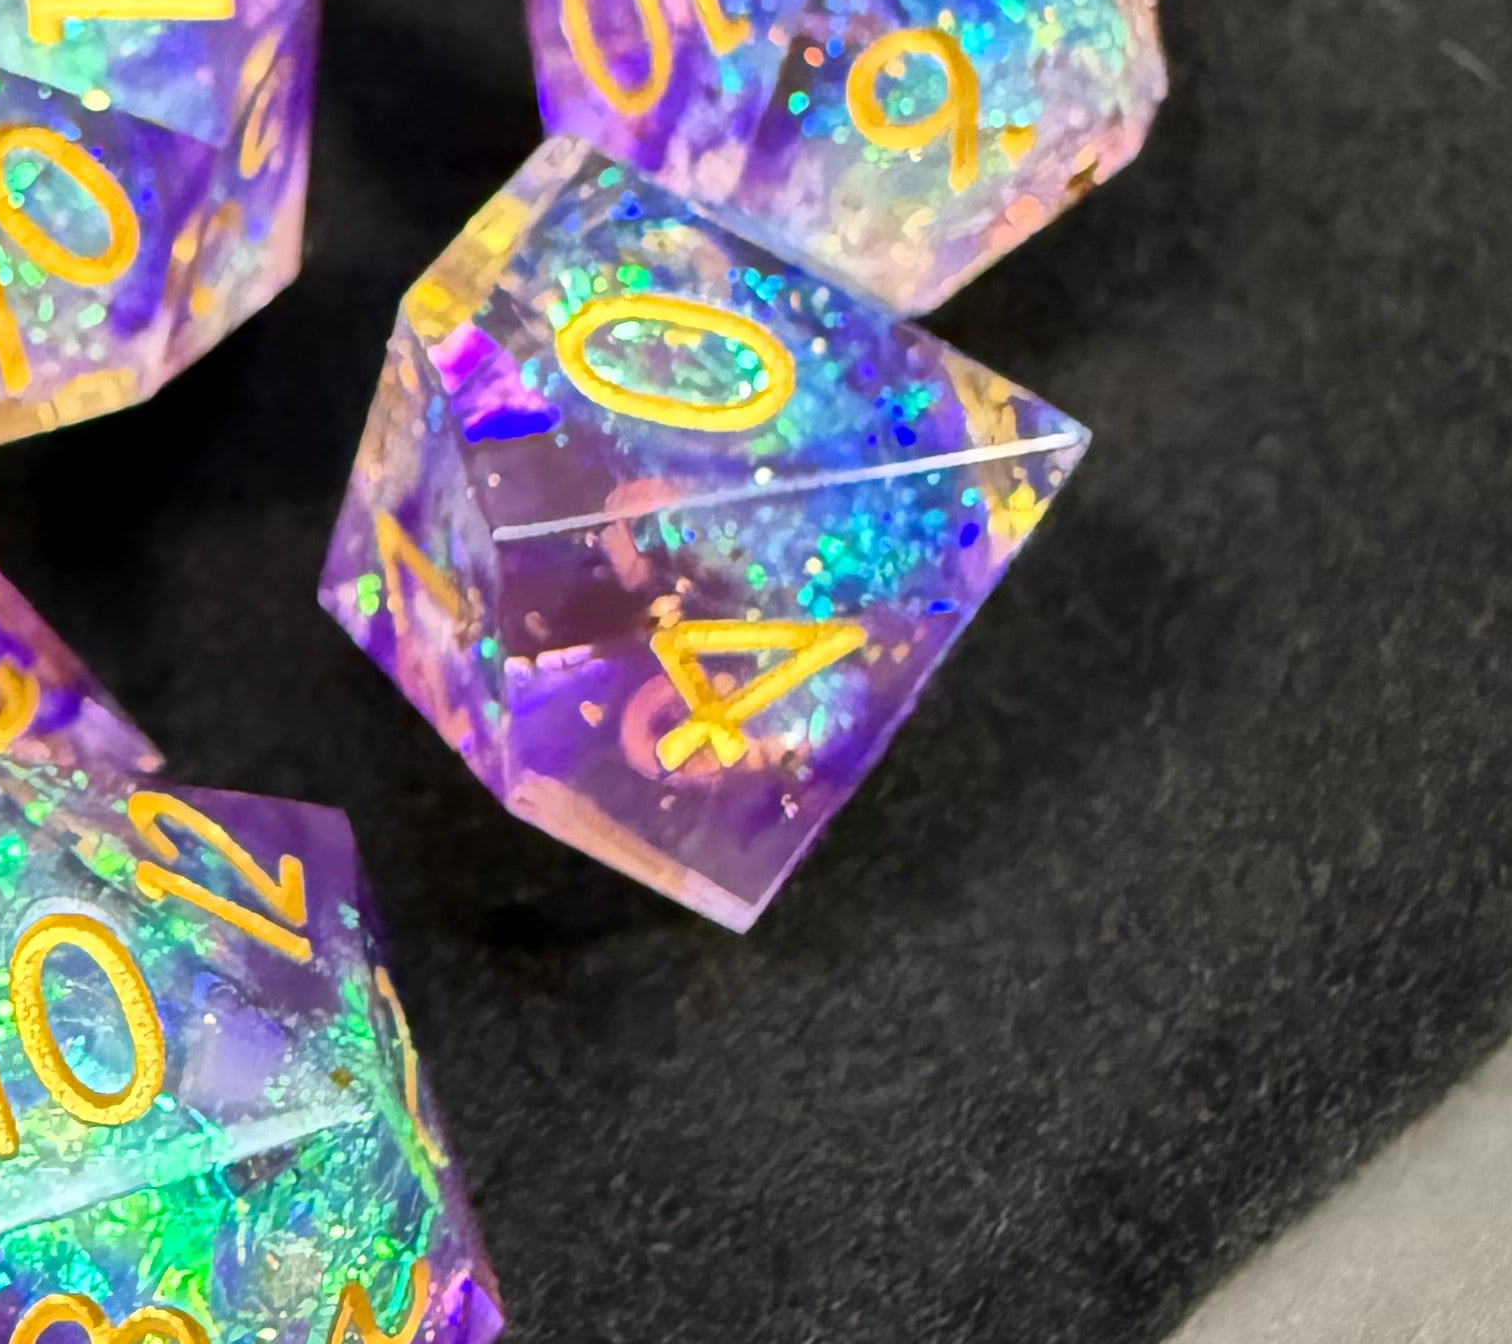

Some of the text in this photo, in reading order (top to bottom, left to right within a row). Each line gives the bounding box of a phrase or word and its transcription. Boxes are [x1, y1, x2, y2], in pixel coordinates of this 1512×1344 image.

[555, 293, 796, 433] 0
[650, 618, 866, 772] 4
[128, 790, 312, 962] 12
